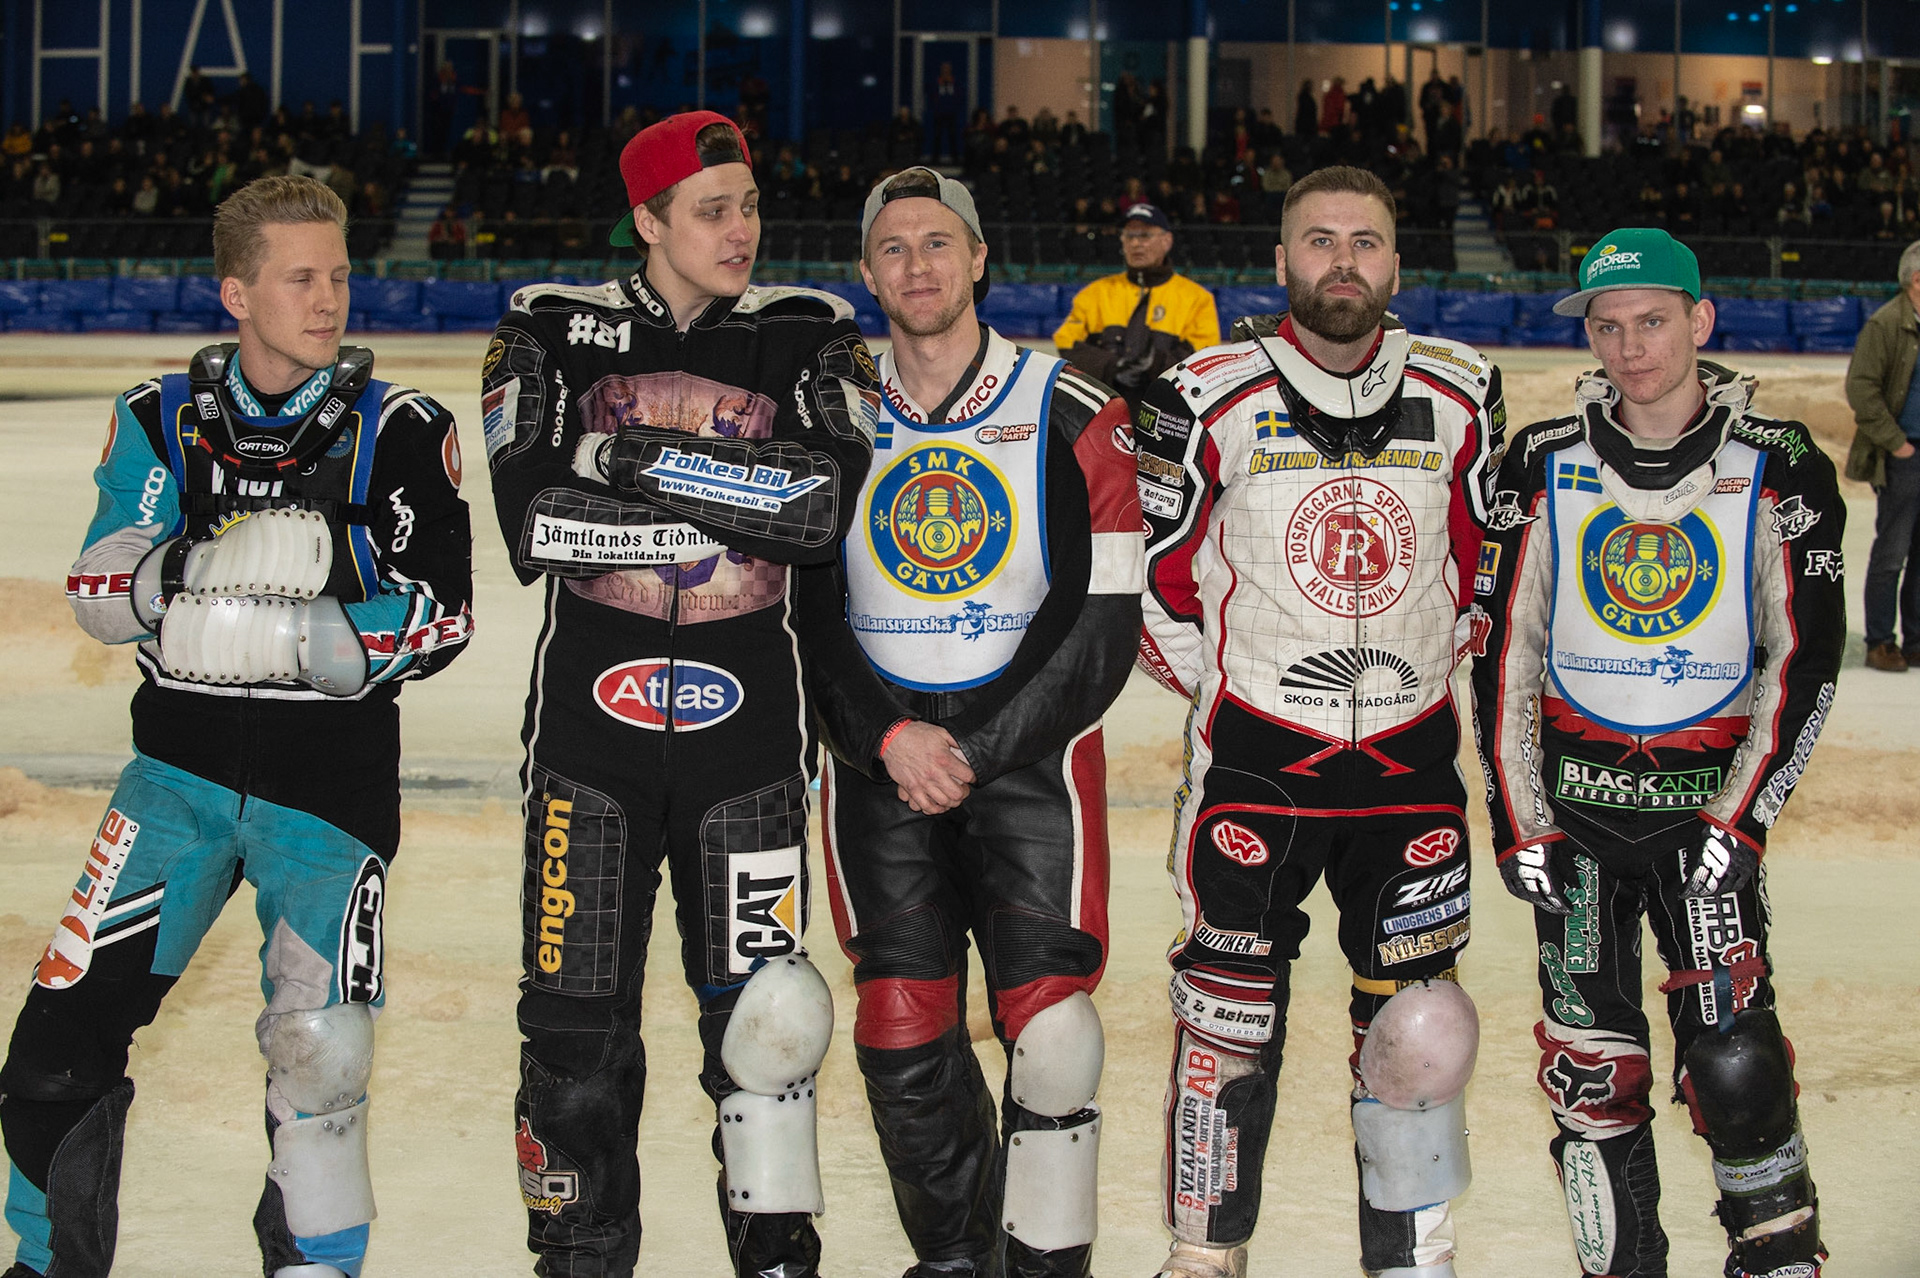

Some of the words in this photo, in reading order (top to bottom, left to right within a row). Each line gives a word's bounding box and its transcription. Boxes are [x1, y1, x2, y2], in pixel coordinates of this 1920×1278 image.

[630, 273, 665, 317] OSO
[567, 313, 632, 353] #81
[1468, 364, 1482, 376] AB
[226, 367, 261, 416] WACO
[283, 370, 330, 416] WACO
[1001, 432, 1029, 441] PARTS
[1002, 424, 1036, 434] RACING
[238, 441, 284, 453] ORTEMA
[910, 451, 974, 476] SMK
[1249, 448, 1318, 474] ÖSTLUND
[1420, 451, 1444, 471] AB
[662, 449, 746, 481] Folkes
[753, 467, 787, 488] Bil
[1717, 478, 1749, 487] RACING
[135, 467, 166, 525] WACO
[1144, 488, 1176, 507] Betong
[1715, 485, 1742, 493] PARTS
[389, 487, 416, 553] WACO
[535, 523, 643, 548] Jämtlands
[1292, 483, 1364, 564] ROSPIGGARNA
[1374, 490, 1414, 571] SPEEDWAY
[571, 549, 592, 560] Din
[597, 550, 676, 562] lokaltidning
[1334, 529, 1370, 576] R
[896, 562, 980, 590] GÄVLE
[1306, 577, 1397, 612] HALLSTAVIK
[851, 611, 953, 633] Mellansvenska
[986, 612, 1022, 632] Städ
[1602, 602, 1684, 634] GÄVLE
[1157, 664, 1174, 679] AB
[1556, 651, 1652, 676] Mellansvenska
[1685, 660, 1720, 679] Städ
[1721, 662, 1740, 679] AB
[609, 674, 725, 710] Atlas
[1283, 694, 1323, 706] SKOG
[1330, 698, 1340, 708] &
[1347, 692, 1417, 709] TRÄDGÅRD
[1769, 714, 1820, 791] JONSSON
[1818, 683, 1830, 709] BIL
[1560, 783, 1642, 806] ENERGY
[1562, 761, 1714, 793] BLACKANT
[72, 812, 127, 910] Life
[538, 798, 576, 974] engcon
[1393, 862, 1467, 908] ZITE
[736, 871, 797, 959] CAT
[1385, 907, 1442, 932] LINDGRENS
[1444, 901, 1459, 916] BIL
[1461, 892, 1470, 908] AB
[350, 886, 382, 1002] HJC
[1196, 926, 1271, 955] BUTIKEN.COM
[1379, 917, 1470, 965] NILSSON
[1170, 975, 1188, 1005] Bygg
[1193, 999, 1206, 1012] &
[1213, 1006, 1270, 1028] Betong
[1209, 1023, 1224, 1031] 070
[1176, 1095, 1198, 1208] SVEALANDS
[1187, 1049, 1219, 1099] AB
[1195, 1100, 1212, 1153] MONTAGE
[1580, 1150, 1597, 1187] AB
